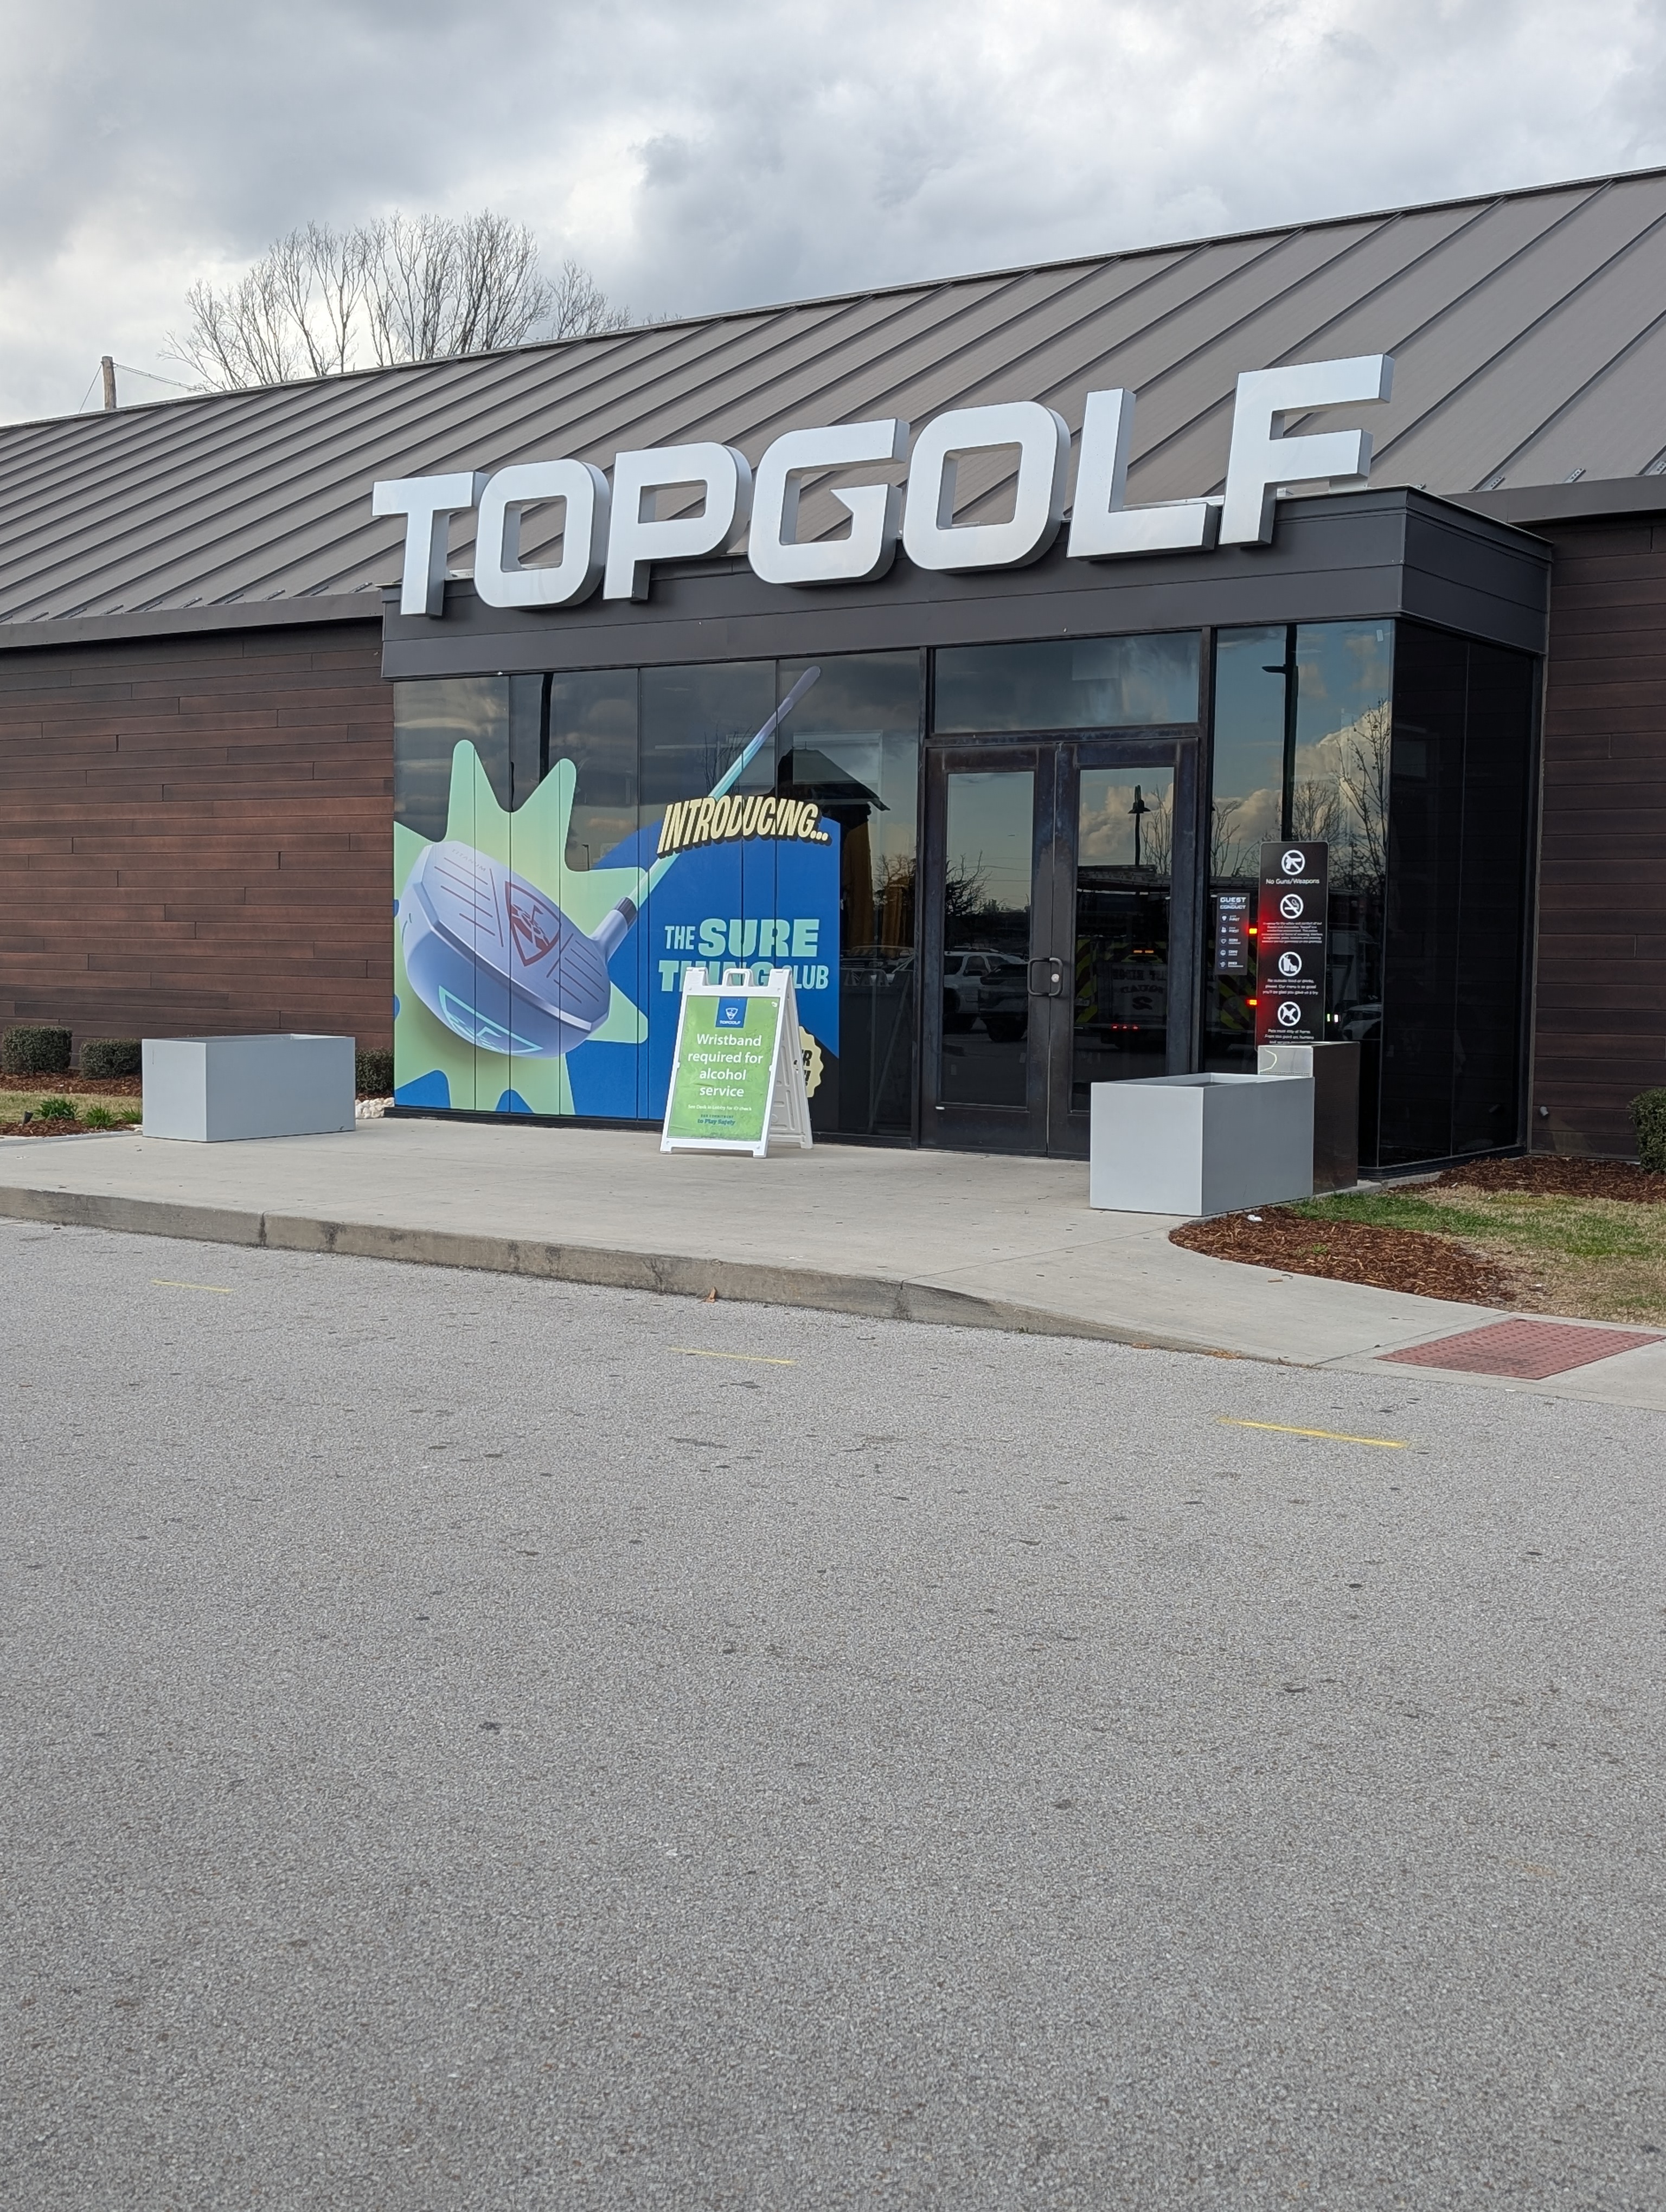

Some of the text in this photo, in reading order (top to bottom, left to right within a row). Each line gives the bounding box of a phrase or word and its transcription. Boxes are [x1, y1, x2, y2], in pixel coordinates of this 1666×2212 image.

[371, 353, 1394, 618] TOPGOLF
[656, 795, 830, 856] INTRODUCING...
[665, 918, 819, 957] THE SURE
[781, 965, 829, 989] LUB
[697, 1033, 762, 1046] Wristband
[688, 1051, 764, 1065] required for
[699, 1068, 746, 1080] alcohol
[700, 1085, 745, 1097] service
